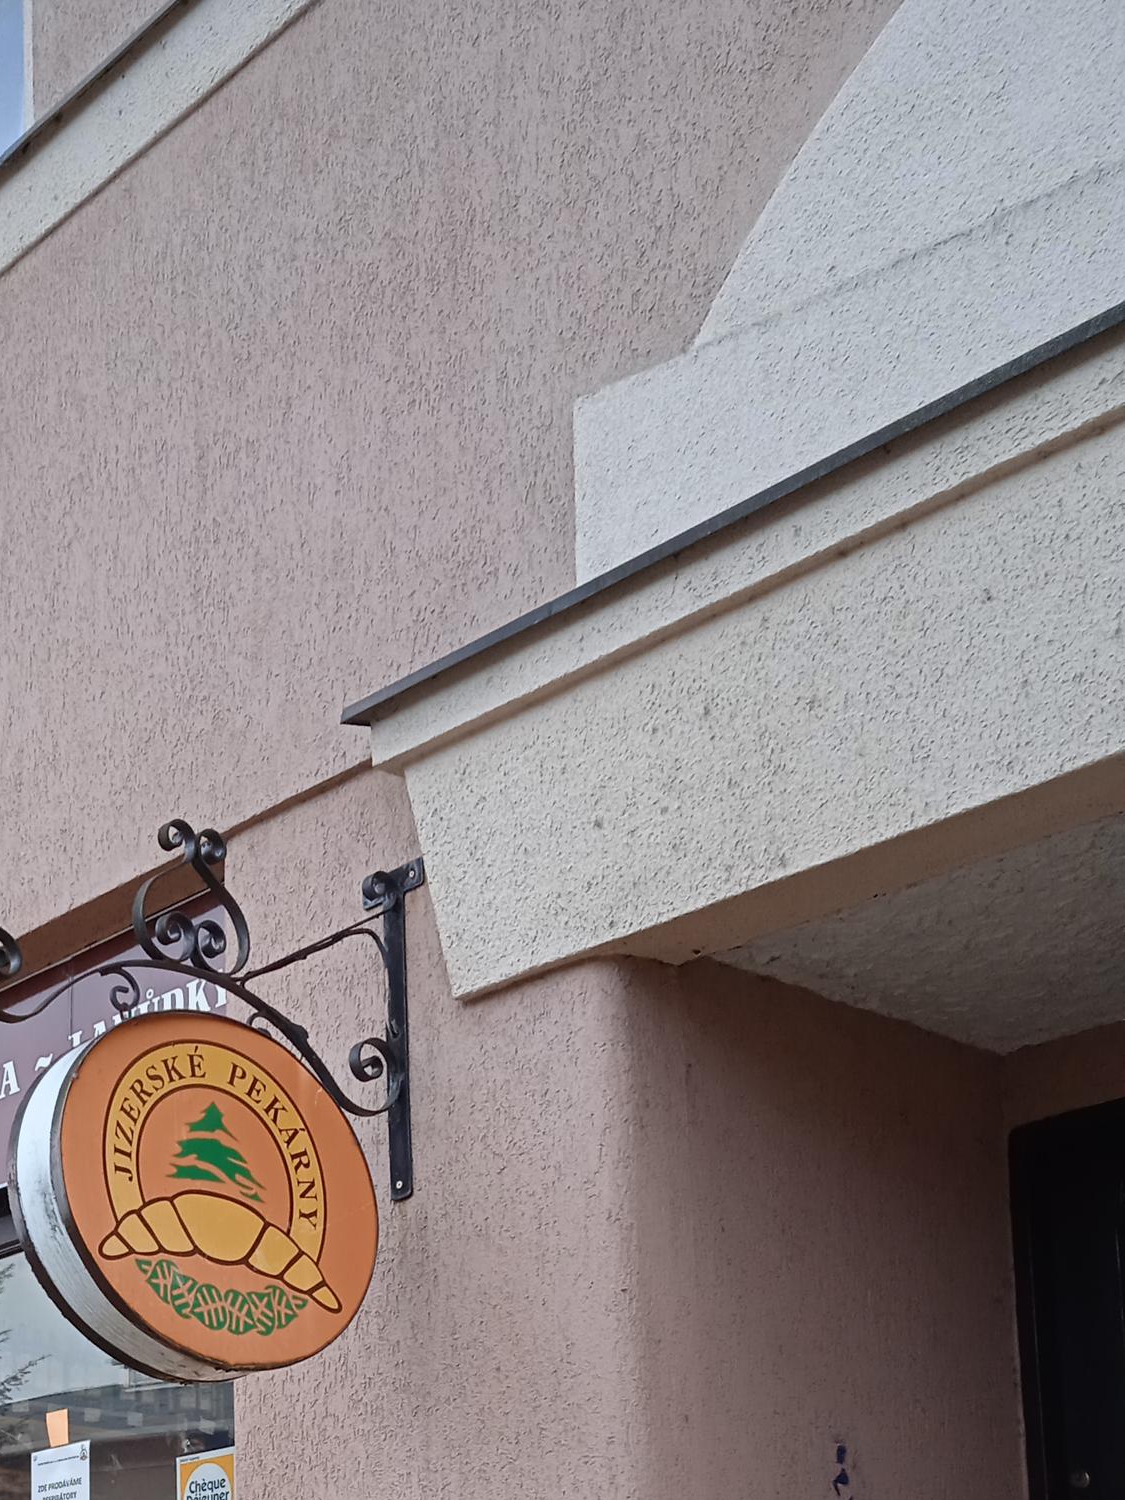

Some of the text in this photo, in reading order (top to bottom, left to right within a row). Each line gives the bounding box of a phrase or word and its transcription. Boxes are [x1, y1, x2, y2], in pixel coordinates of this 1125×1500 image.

[114, 1046, 319, 1229] JIZERSKÉ PEKÁRNY
[37, 1485, 47, 1493] ZDE
[189, 1478, 226, 1494] Chèque
